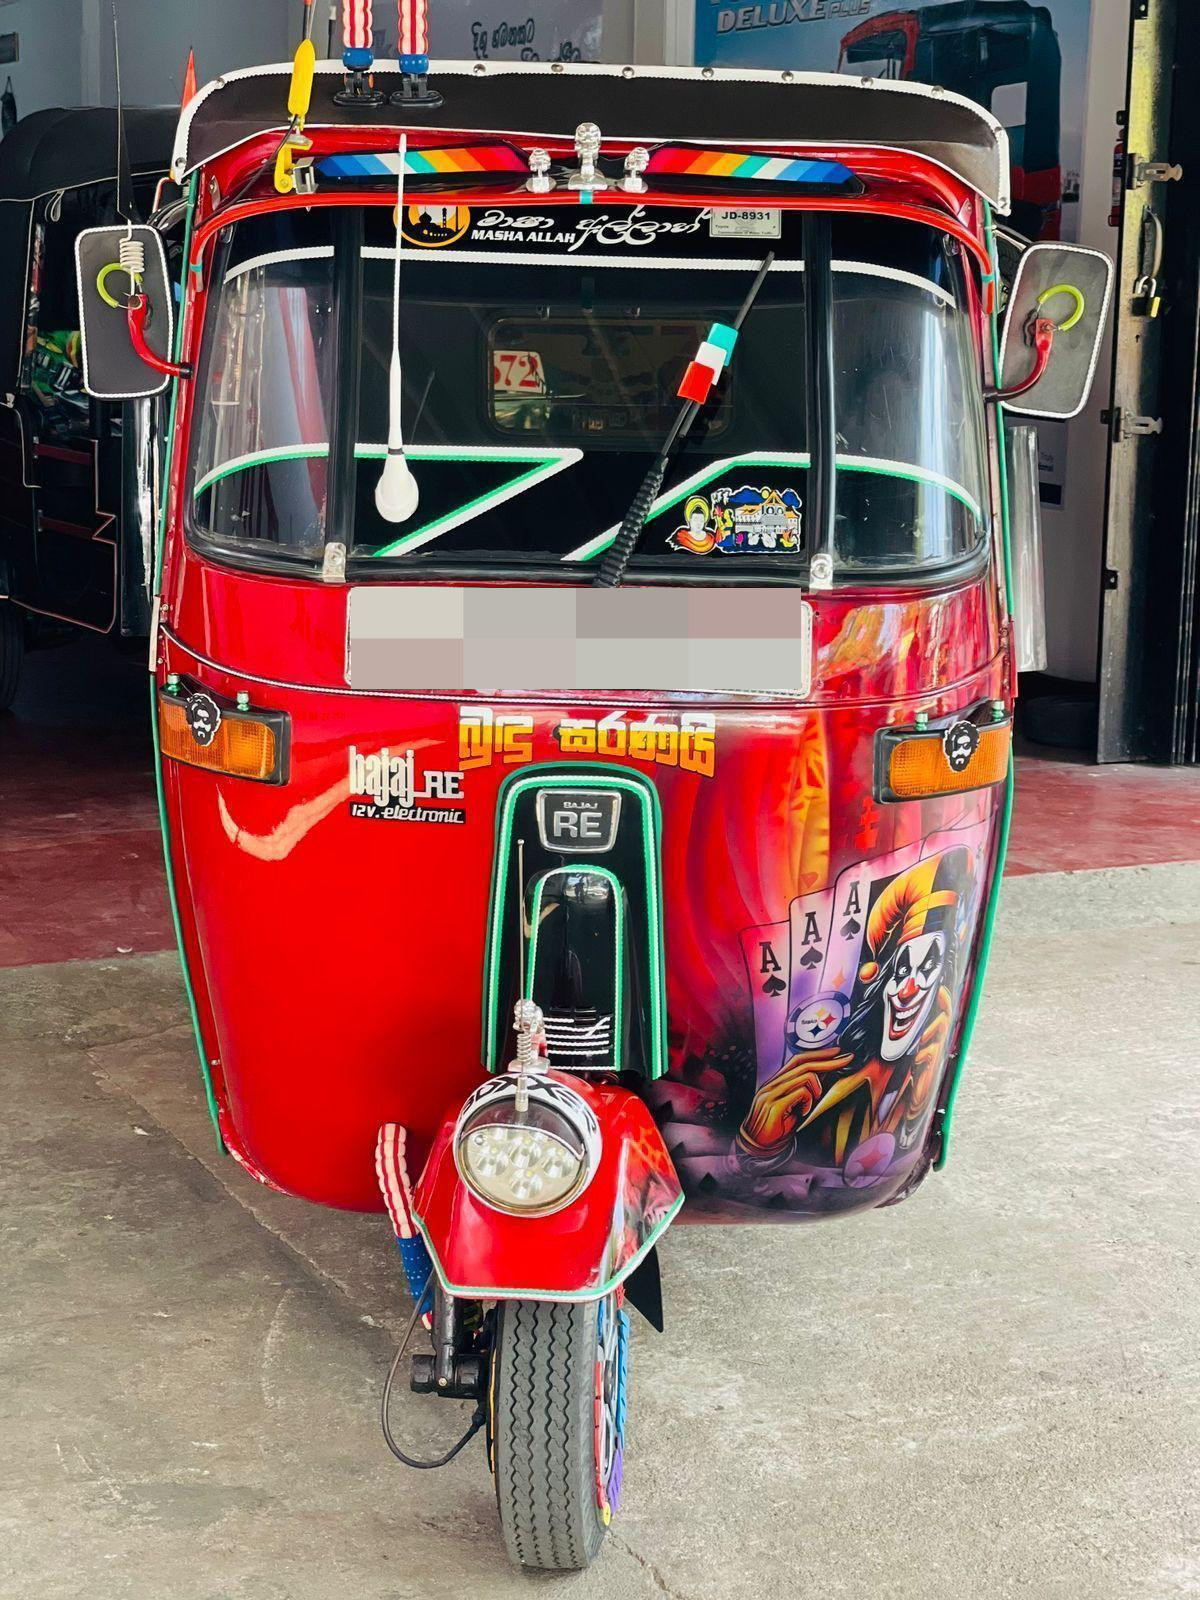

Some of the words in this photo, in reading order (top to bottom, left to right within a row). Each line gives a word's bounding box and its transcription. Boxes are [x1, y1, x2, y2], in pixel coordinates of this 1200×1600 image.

[717, 0, 825, 34] DELUXE
[826, 0, 871, 19] PLUS
[722, 211, 771, 221] JD-8931
[471, 229, 524, 242] MASHA
[526, 231, 577, 243] ALLAH
[349, 745, 415, 808] bajaj
[422, 770, 465, 799] RE
[553, 810, 603, 838] RE
[843, 881, 861, 917] A
[801, 911, 823, 946] A
[759, 941, 782, 974] A
